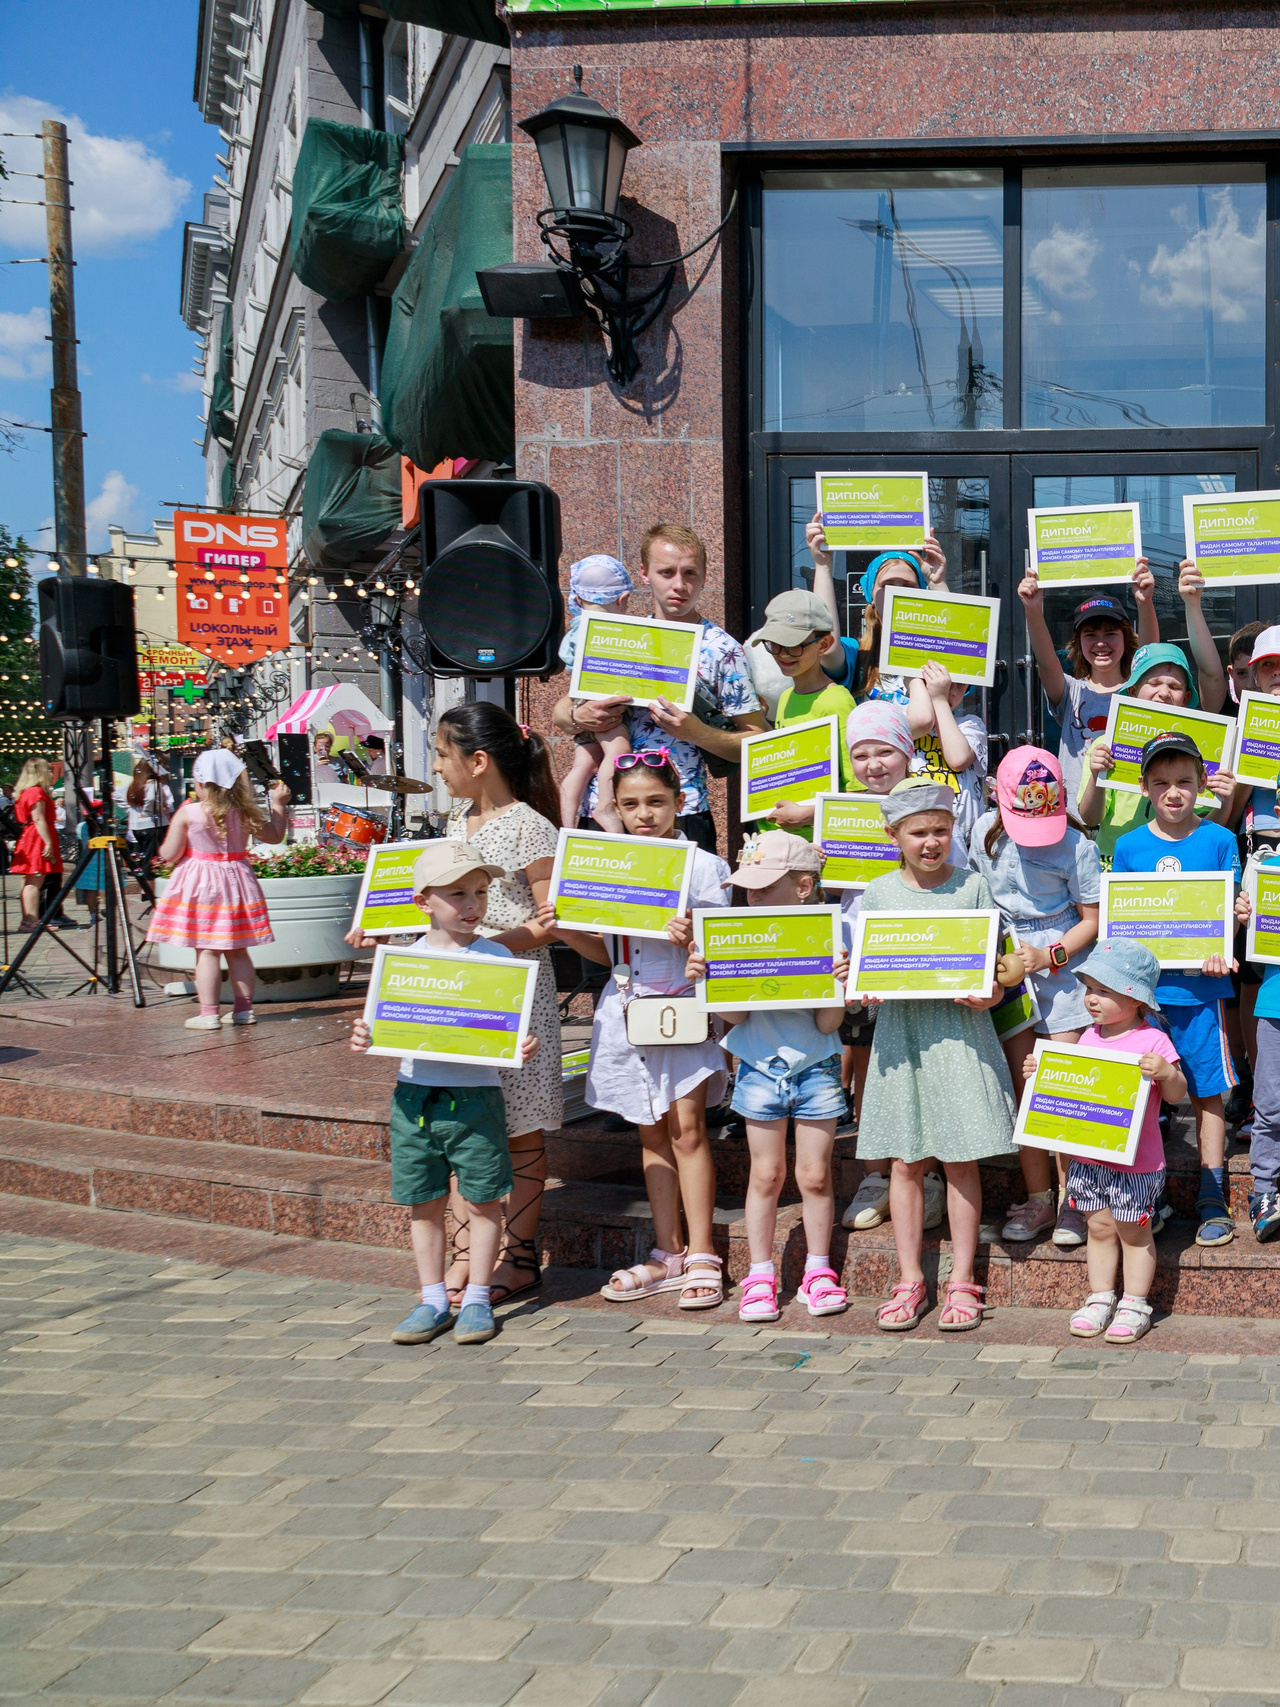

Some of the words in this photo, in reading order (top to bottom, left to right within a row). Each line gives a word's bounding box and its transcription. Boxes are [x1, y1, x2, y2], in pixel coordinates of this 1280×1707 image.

[826, 492, 878, 500] ДИПЛОМ
[1198, 516, 1254, 529] ДИПЛОМ
[184, 520, 278, 548] DNS
[1040, 526, 1091, 537] ДИПЛОМ
[204, 552, 260, 567] ГИПЕР
[1080, 600, 1114, 612] PRINCESS
[895, 610, 946, 624] ДИПЛОМ
[190, 622, 278, 636] ЦОКОЛЬНЫЙ
[216, 636, 252, 646] ЭТАЖ
[590, 634, 647, 649] ДИПЛОМ
[142, 655, 196, 665] РЕМОНТ
[751, 748, 794, 767] ДИПЛОМ
[568, 854, 631, 870] ДИПЛОМ
[1112, 897, 1173, 908] ДИПЛОМ
[708, 932, 776, 946] ДИПЛОМ
[868, 933, 933, 943] ДИПЛОМ
[387, 974, 463, 990] ДИПЛОМ
[413, 1014, 457, 1023] КОНДИТЕРУ
[445, 1010, 505, 1020] ТАЛАНТЛИВОМУ
[1040, 1068, 1095, 1086] ДИПЛОМ
[1033, 1103, 1055, 1111] ЮНОМУ
[1055, 1107, 1087, 1117] КОНДИТЕРУ
[1055, 1100, 1078, 1108] САМОМУ
[1078, 1104, 1123, 1116] ТАЛАНТЛИВОМУ
